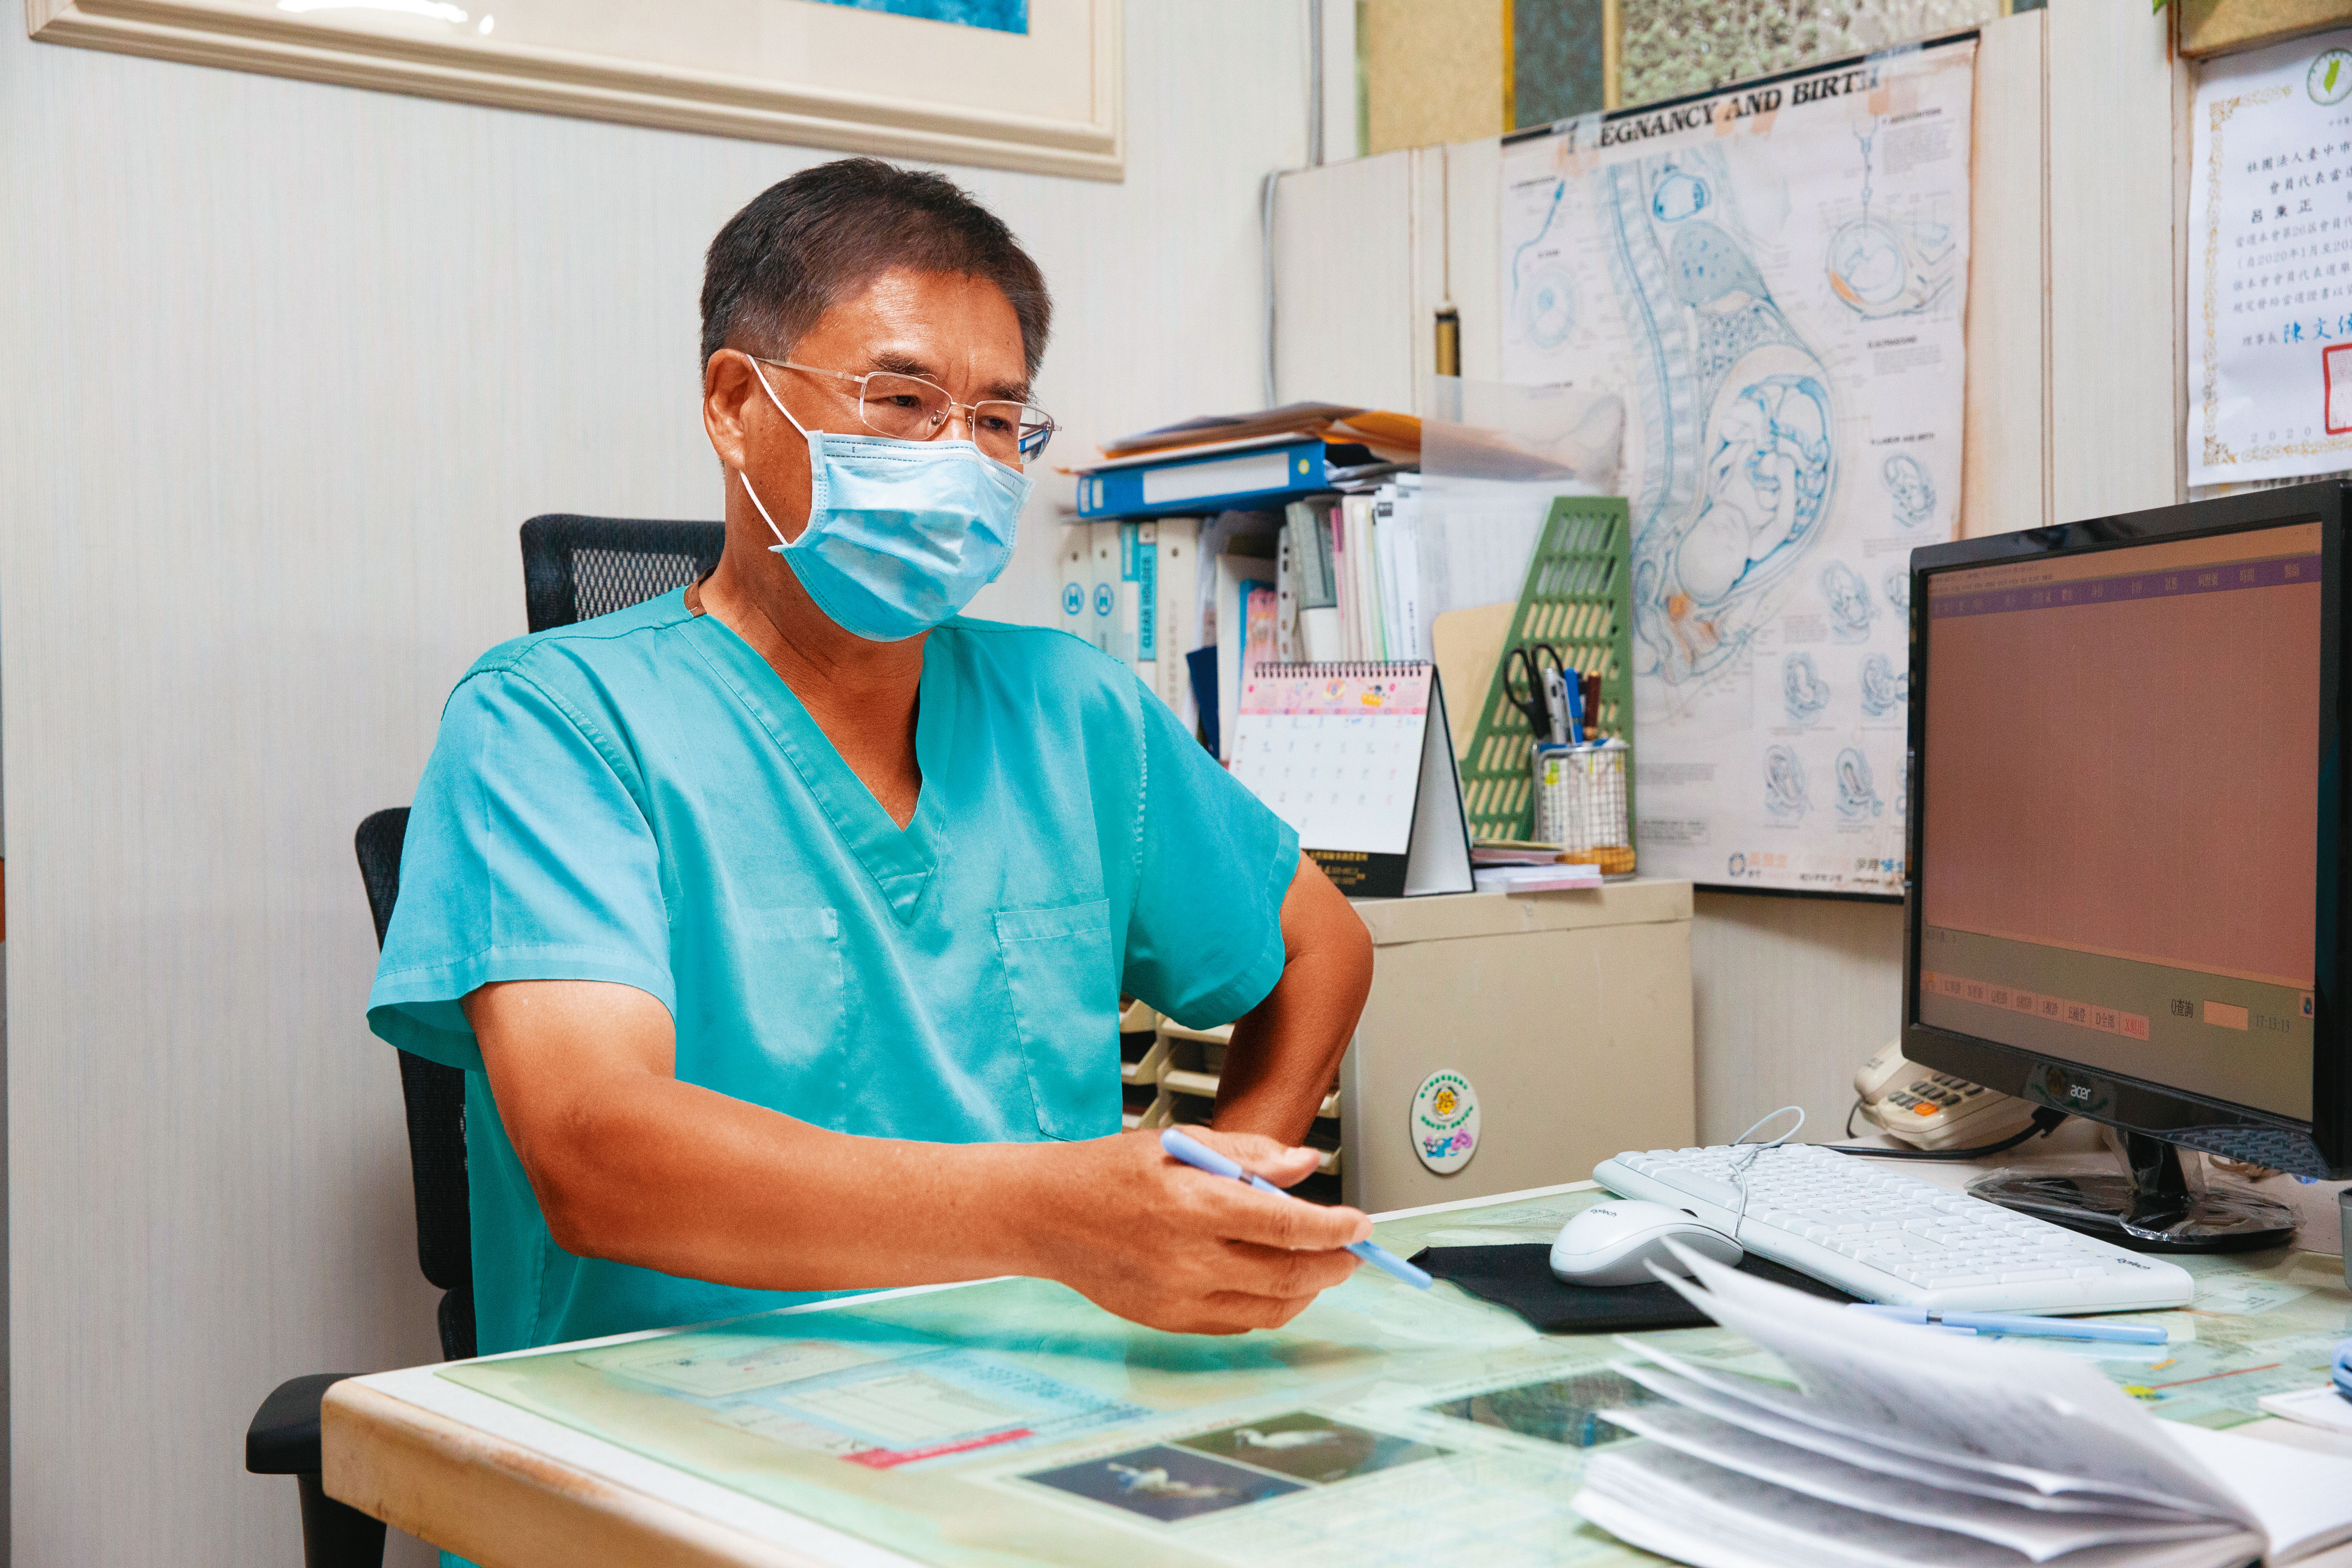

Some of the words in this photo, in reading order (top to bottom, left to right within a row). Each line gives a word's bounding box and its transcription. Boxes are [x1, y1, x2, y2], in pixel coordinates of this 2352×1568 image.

[1723, 89, 1782, 121] AND
[2171, 998, 2194, 1018] Q查詢
[2095, 1012, 2115, 1029] D全部
[2070, 1085, 2091, 1101] acer
